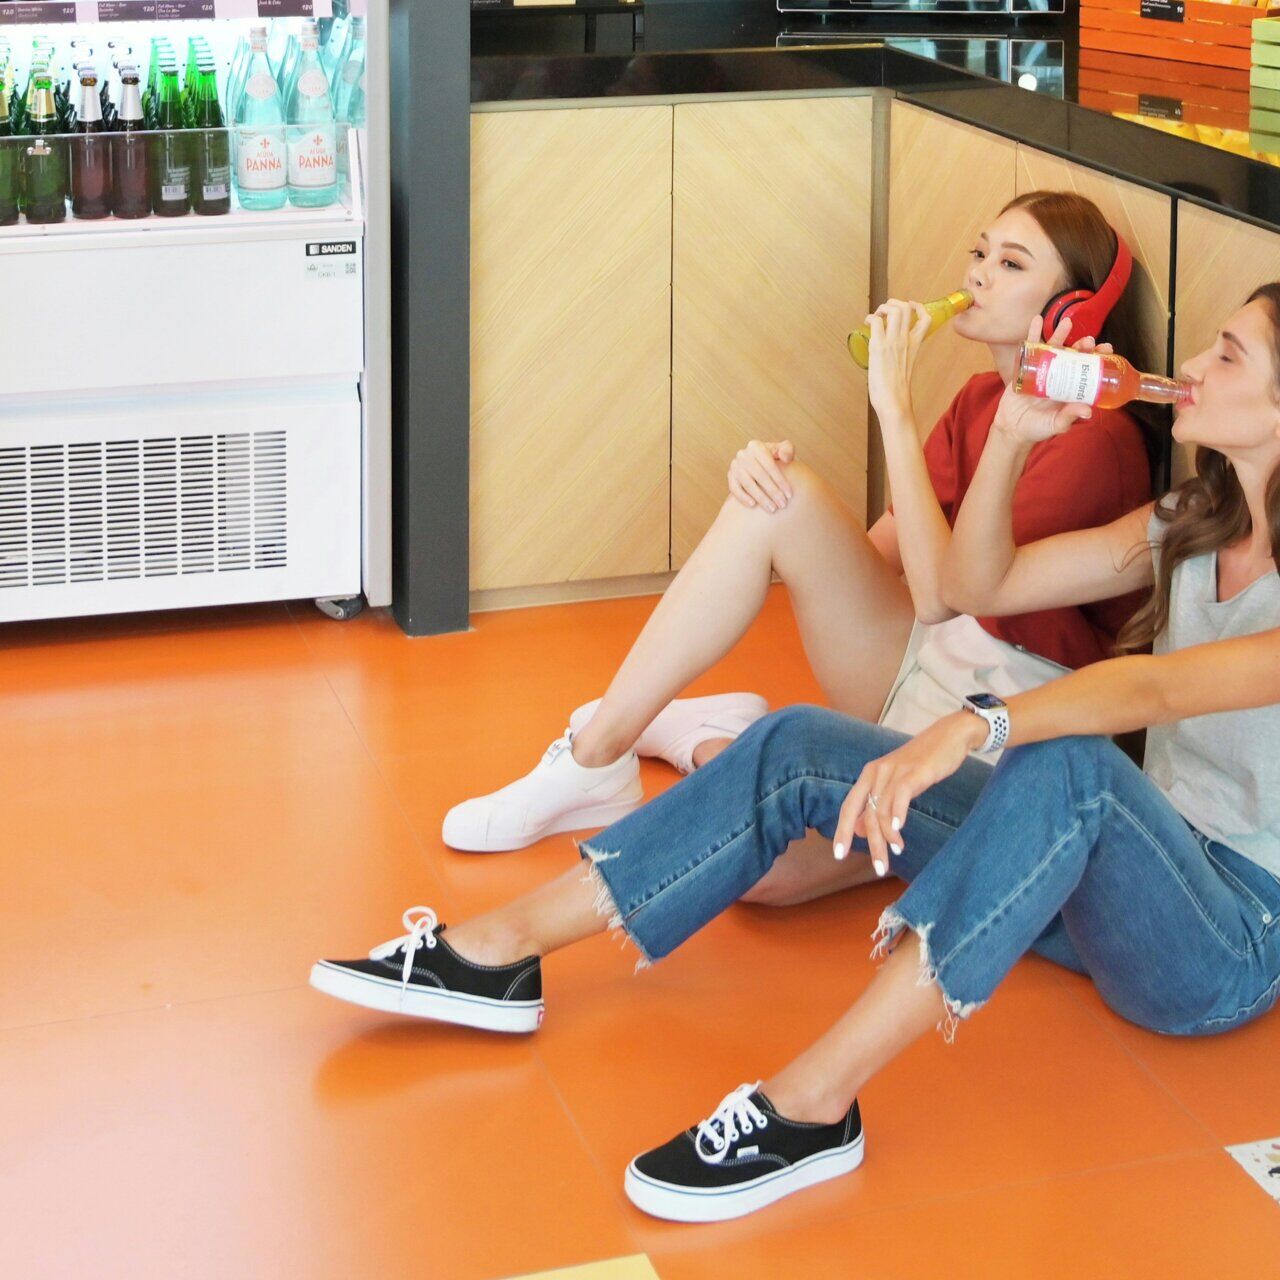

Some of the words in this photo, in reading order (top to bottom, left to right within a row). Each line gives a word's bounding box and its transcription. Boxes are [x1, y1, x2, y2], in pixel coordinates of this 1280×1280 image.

[246, 158, 282, 171] PANNA
[299, 154, 334, 169] PANNA
[321, 244, 352, 253] SANDEN
